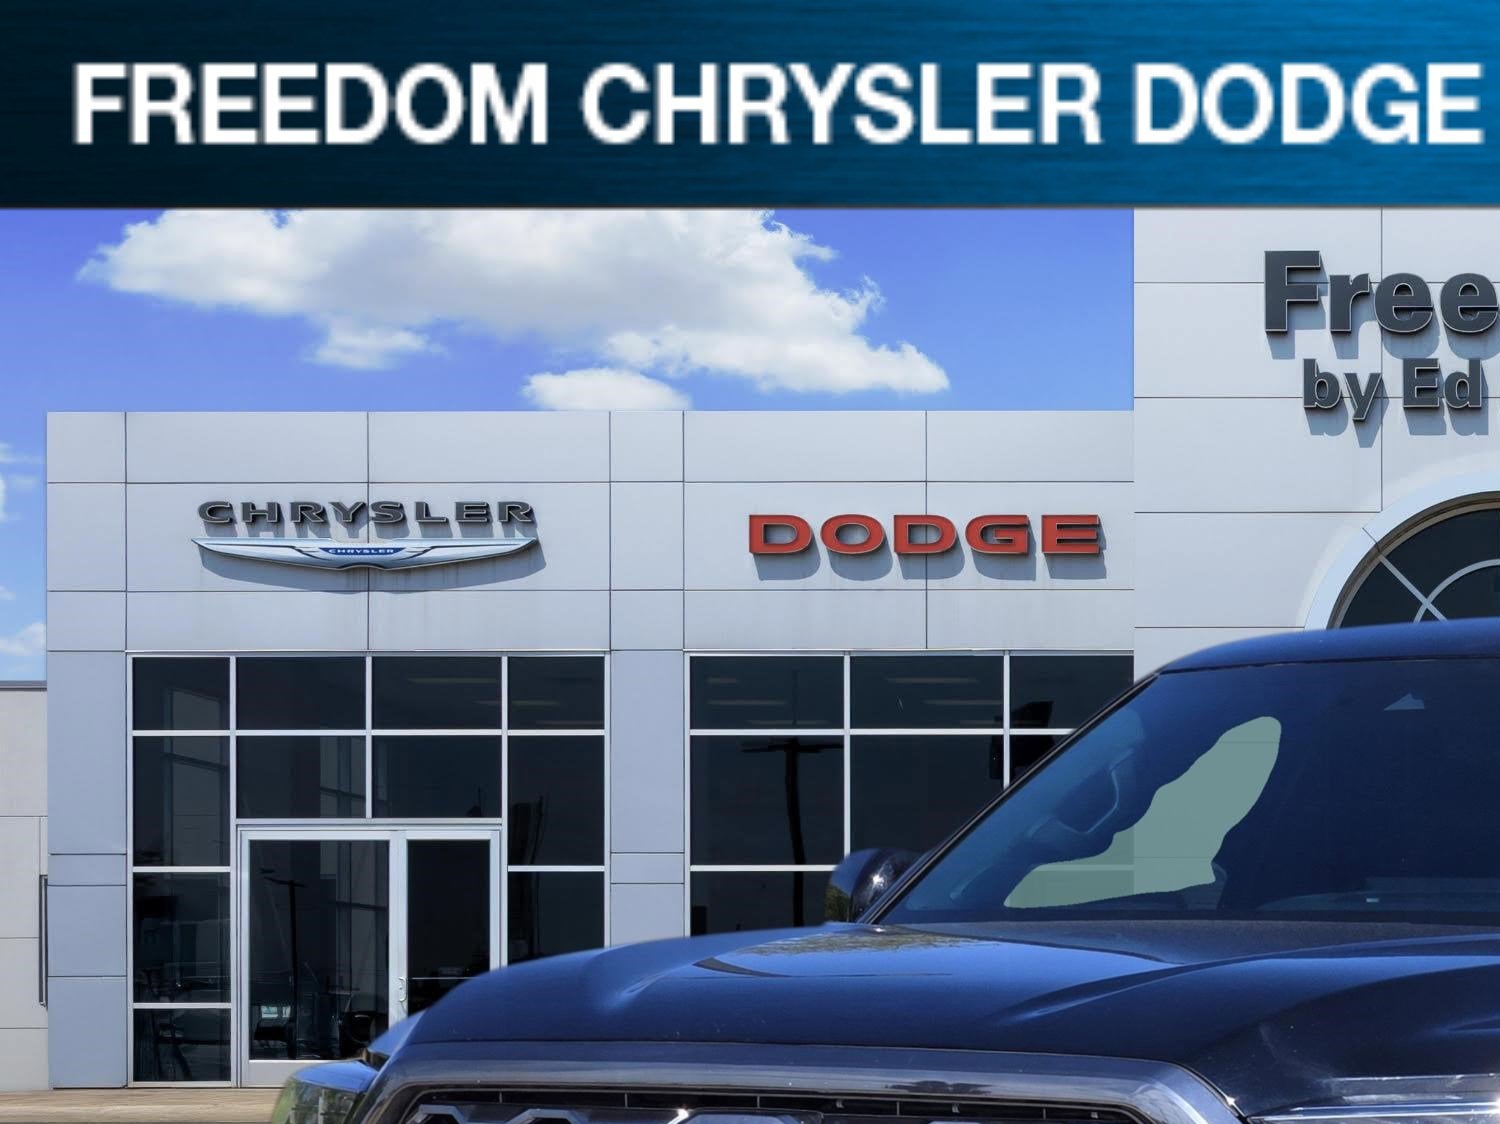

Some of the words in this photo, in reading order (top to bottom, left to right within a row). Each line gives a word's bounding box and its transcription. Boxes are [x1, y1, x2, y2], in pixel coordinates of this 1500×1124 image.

[1303, 358, 1382, 421] by
[1402, 358, 1483, 409] Ed
[198, 500, 534, 524] CHRYSLER
[748, 513, 1103, 556] DODGE
